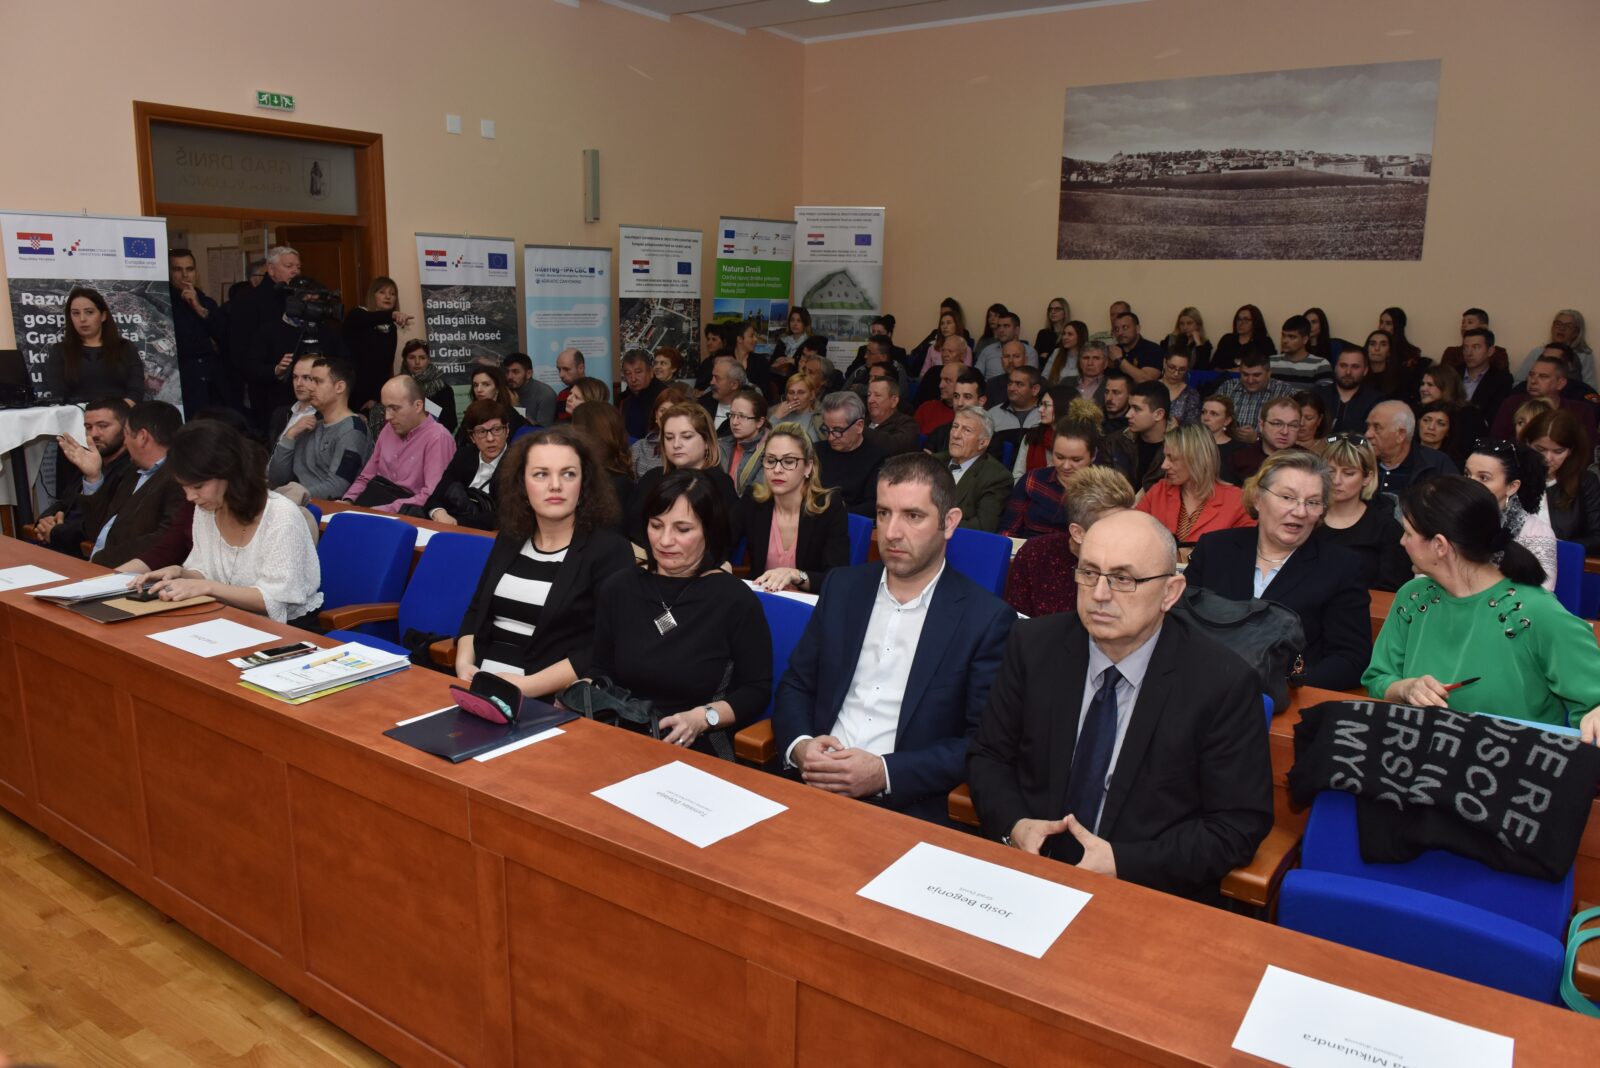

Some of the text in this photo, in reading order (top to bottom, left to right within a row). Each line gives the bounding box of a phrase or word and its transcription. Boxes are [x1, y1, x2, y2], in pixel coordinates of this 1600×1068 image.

[722, 264, 745, 273] Natura
[426, 298, 471, 312] Sanacija
[427, 314, 487, 328] odlagališta
[428, 329, 502, 344] otpada Moseć
[28, 350, 49, 364] kr
[429, 346, 471, 358] u Gradu
[436, 362, 466, 374] rnišu
[31, 371, 43, 383] u
[926, 885, 1014, 918] Josip Begonja
[1303, 1033, 1388, 1067] Mikulandra
